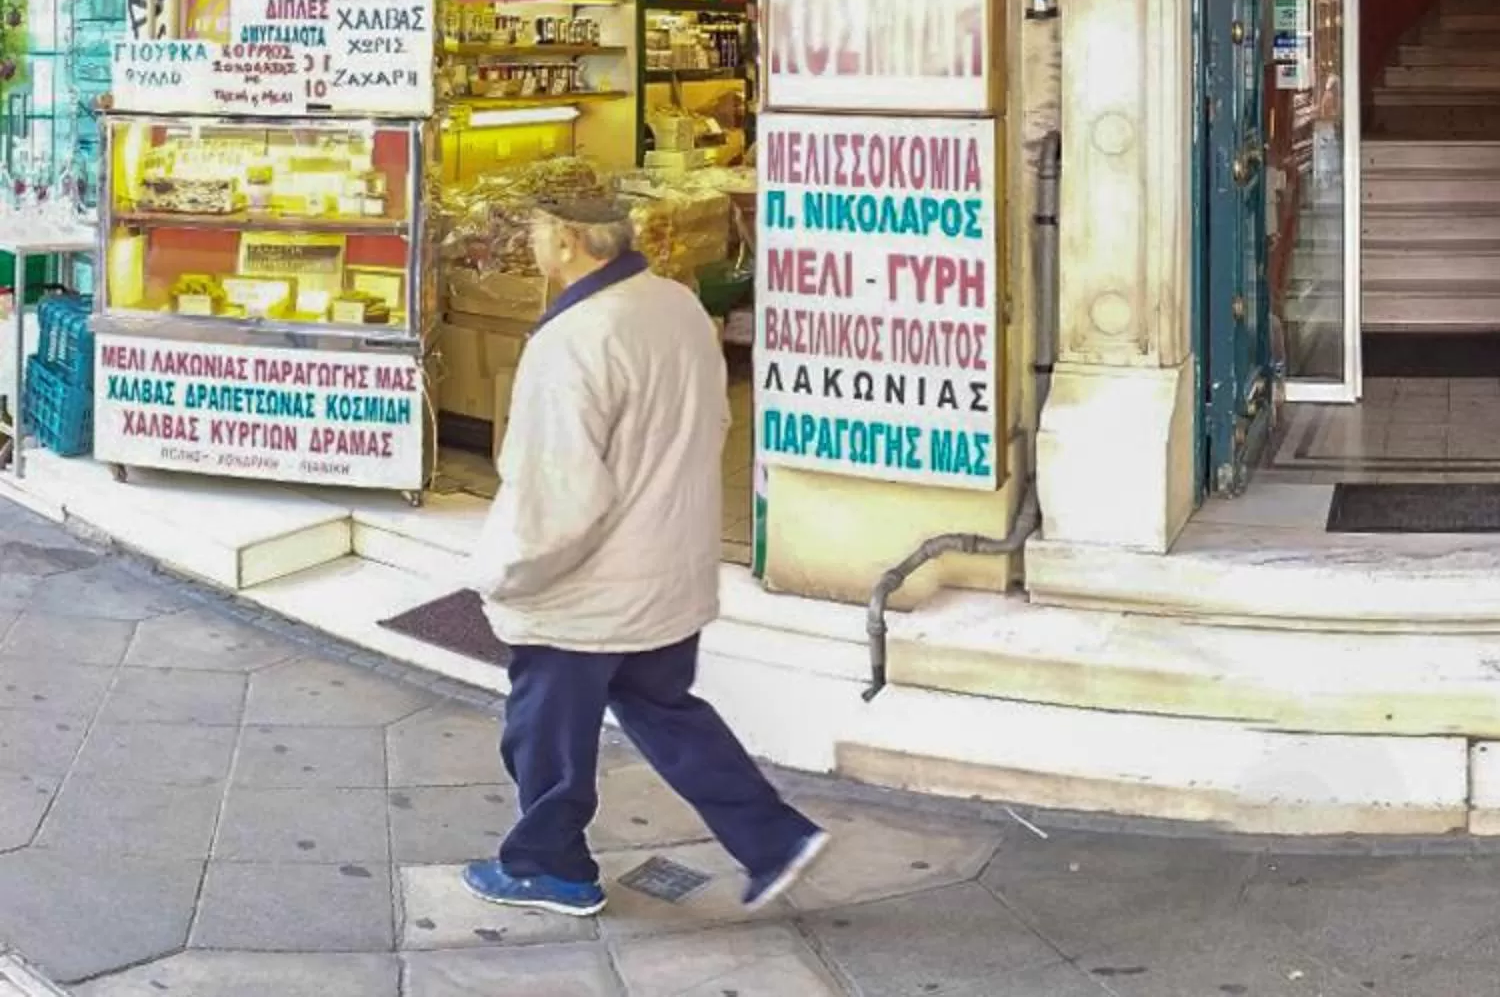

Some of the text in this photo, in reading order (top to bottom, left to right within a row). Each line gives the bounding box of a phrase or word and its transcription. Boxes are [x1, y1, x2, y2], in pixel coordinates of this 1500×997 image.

[337, 7, 426, 31] ΧΑΛΒΑΣ
[766, 132, 982, 192] ΜΕΛΙΣΣΟΚΟΜΙΑ
[765, 190, 984, 239] Π. ΝΙΚΟΛΑΡΟΣ
[767, 248, 854, 298] ΜΕΛΙ
[887, 254, 985, 308] ΓΥΡΗ
[765, 307, 987, 371] ΒΑΣΙΛΙΚΟΣ ΠΟΛΤΟΣ
[101, 345, 417, 391] ΜΕΛΙ ΛΑΚΩΝΙΑΣ ΠΑΡΑΓΩΓΗΣ ΜΑΣ
[764, 362, 989, 413] ΛΑΚΩΝΙΑΣ
[107, 376, 411, 424] ΧΑΛΒΑΣ ΔΡΑΠΕΤΣΩΝΑΣ ΚΟΣΜΙΔΗ
[123, 410, 393, 457] ΧΑΛΒΑΣ ΚΥΡΓΙΩΝ ΔΡΑΜΑΣ
[763, 410, 991, 477] ΠΑΡΑΓΩΓΗΣ ΜΑΣ
